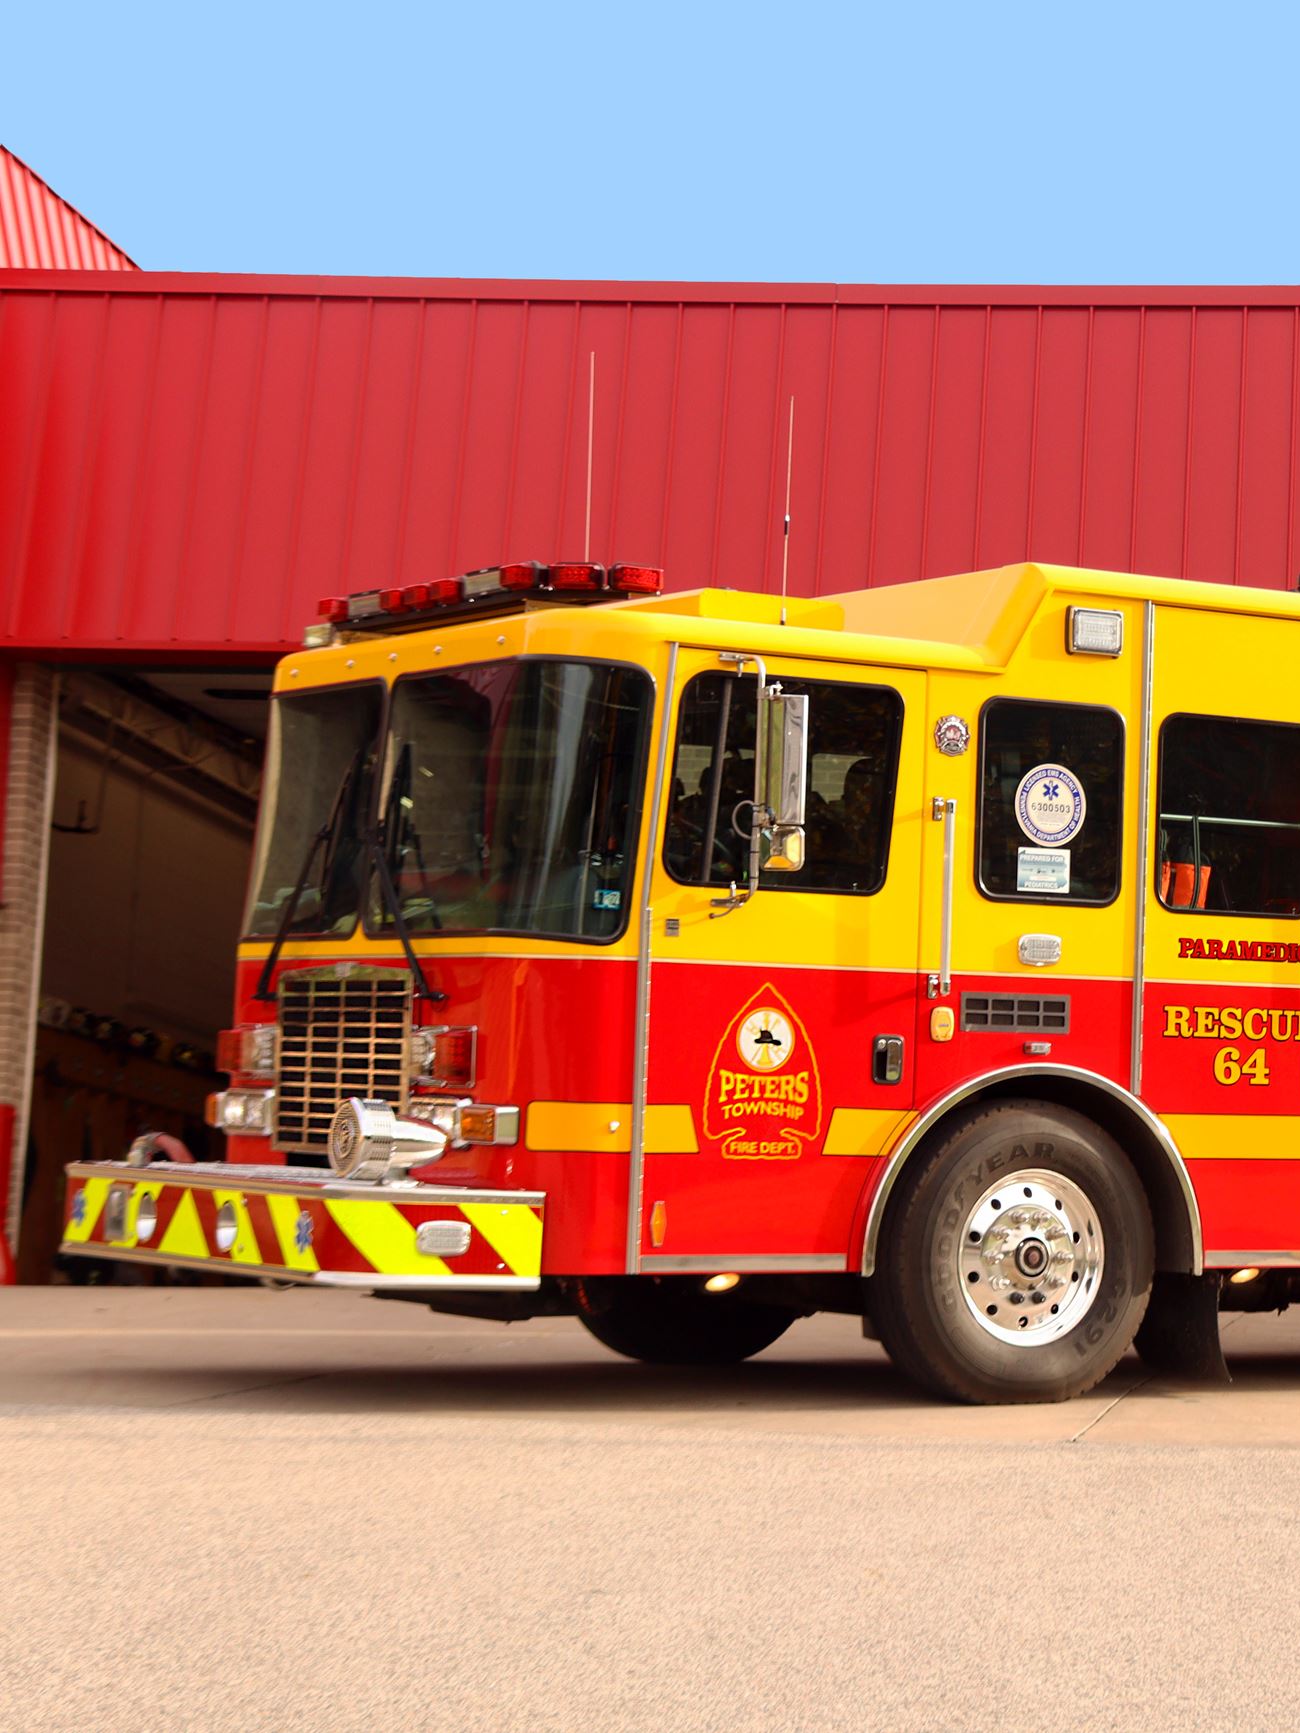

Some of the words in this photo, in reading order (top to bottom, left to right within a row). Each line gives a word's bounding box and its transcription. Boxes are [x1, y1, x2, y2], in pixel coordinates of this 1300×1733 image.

[1059, 773, 1078, 794] AGENCY
[1031, 802, 1071, 814] 6300503
[1213, 1046, 1270, 1086] 64
[718, 1069, 809, 1103] PETERS
[721, 1101, 804, 1120] TOWNSHIP
[730, 1141, 758, 1153] FIRE
[759, 1141, 796, 1154] DEPT.
